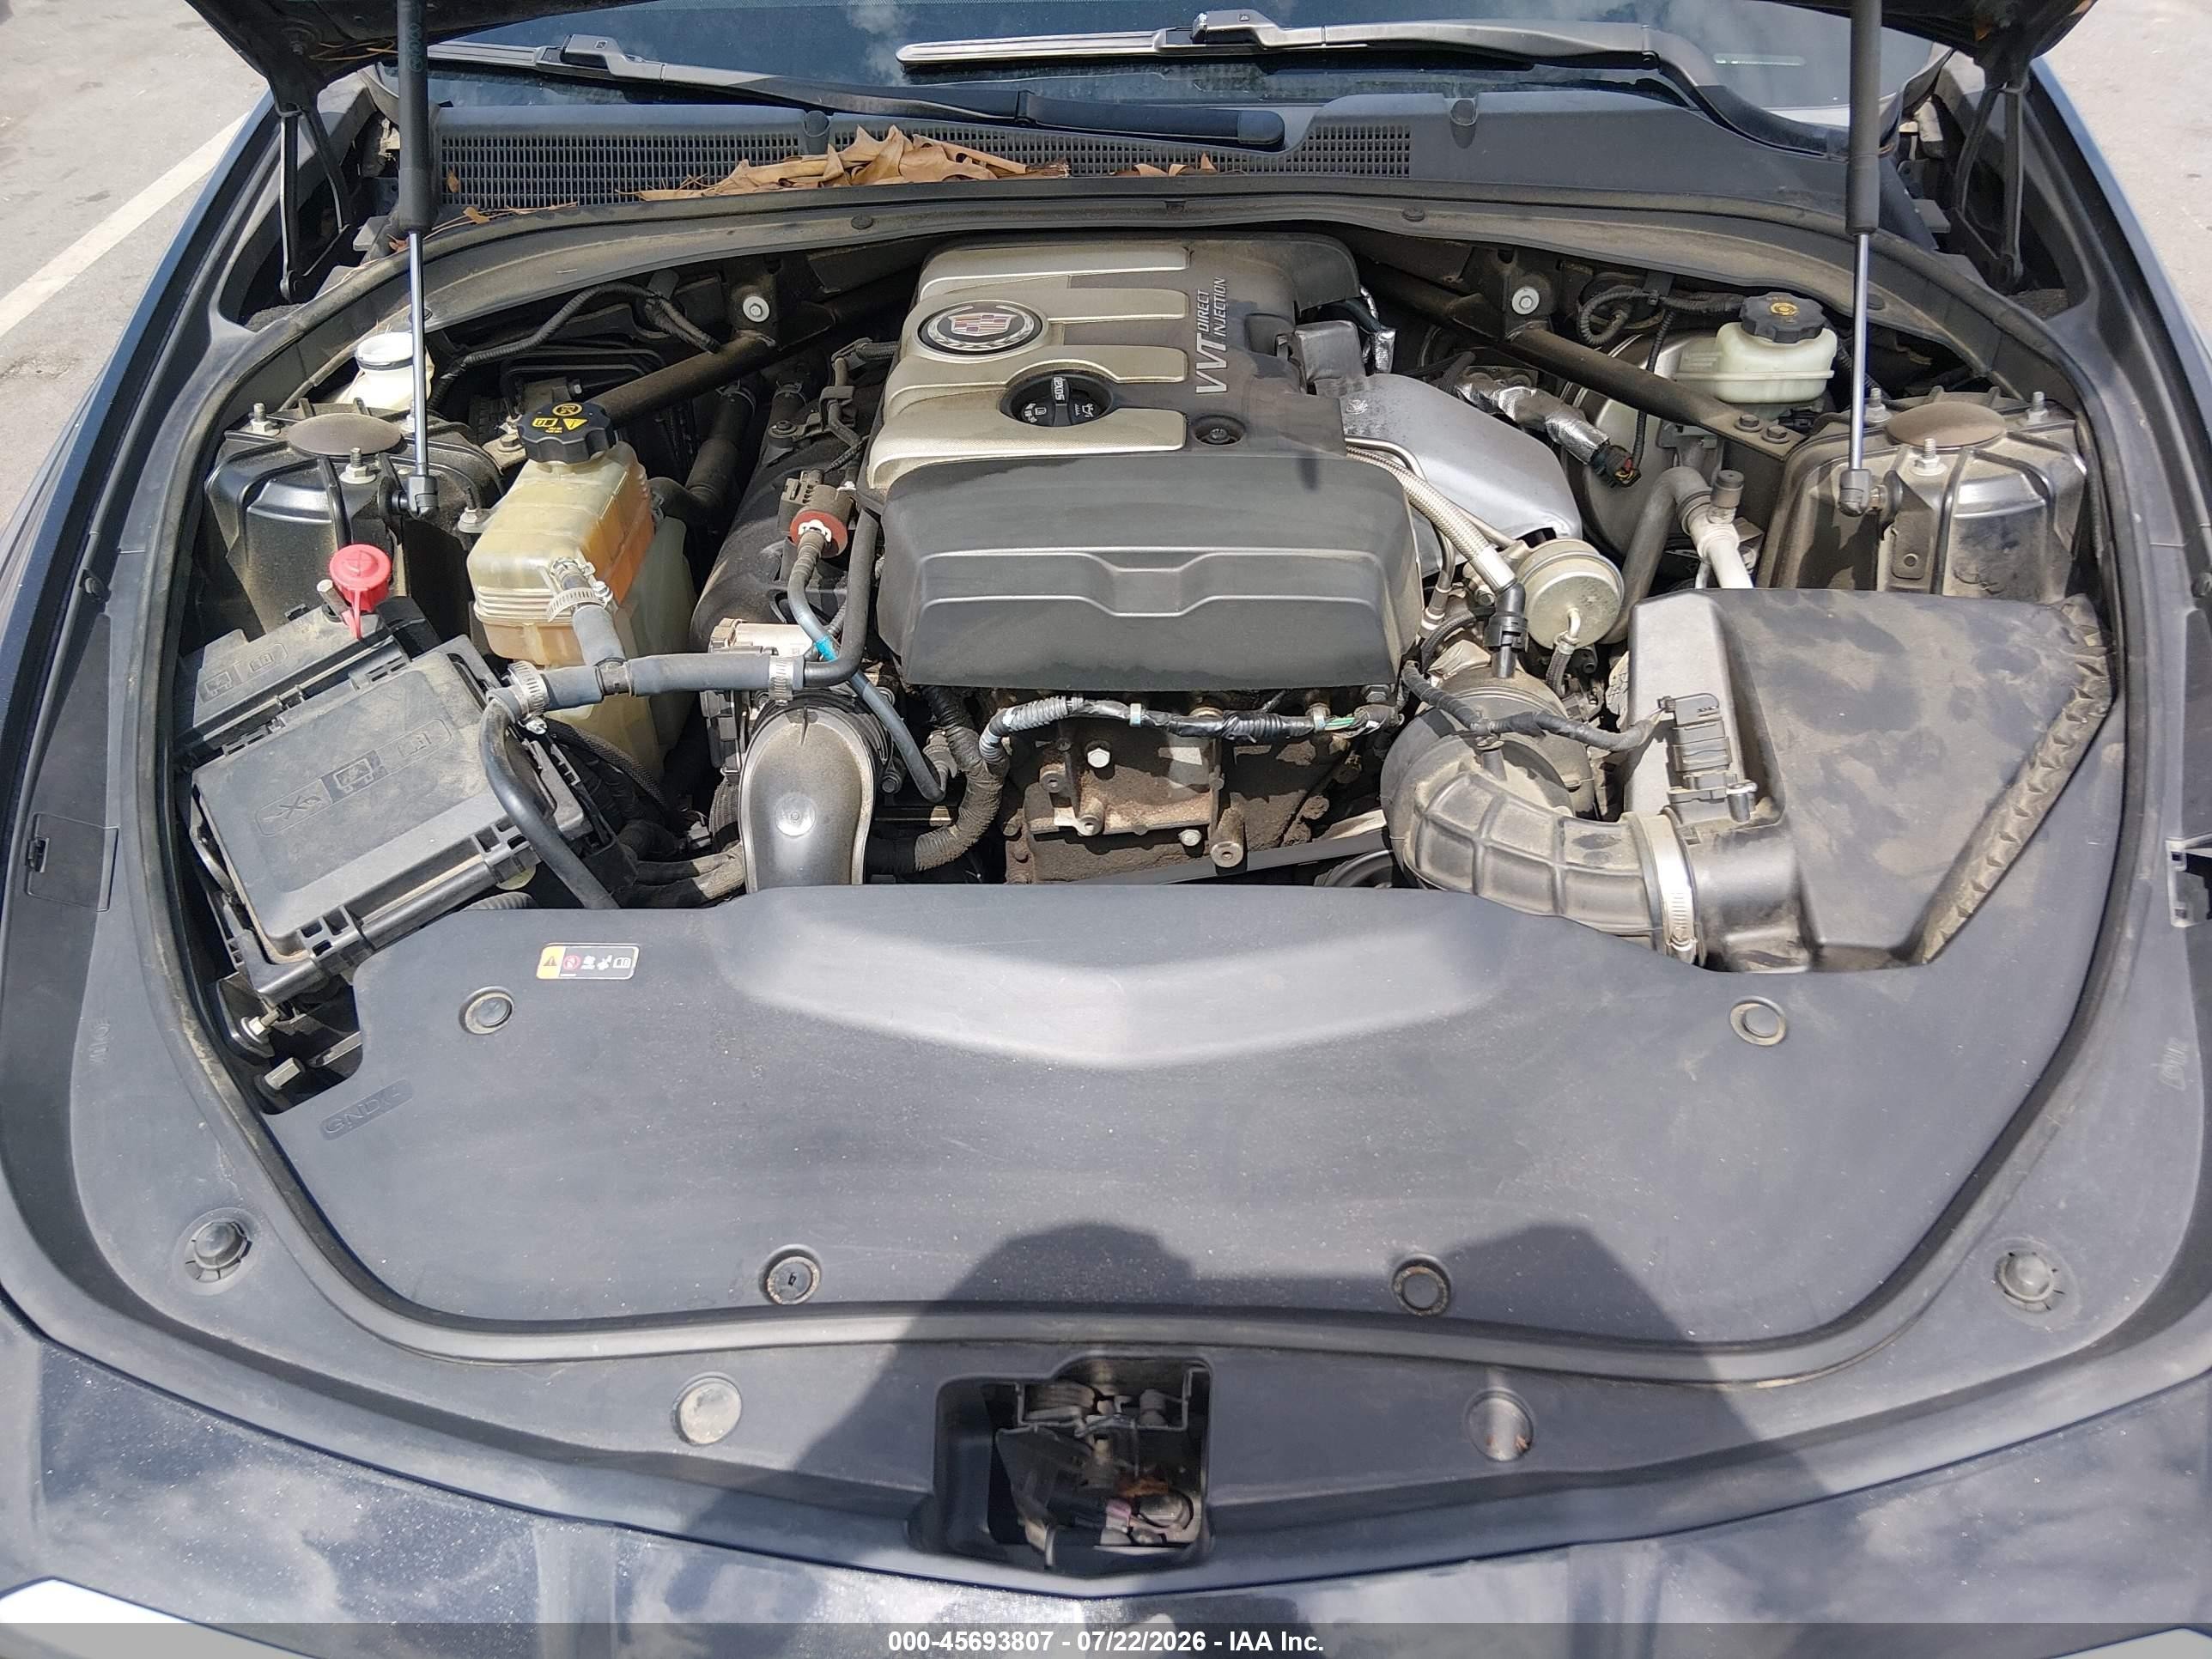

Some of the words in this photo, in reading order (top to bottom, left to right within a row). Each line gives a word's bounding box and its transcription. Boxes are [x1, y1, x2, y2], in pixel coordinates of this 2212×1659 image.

[1197, 289, 1210, 332] DIRECT
[1213, 276, 1227, 337] INJECTION
[1053, 376, 1066, 401] dexos
[1196, 332, 1227, 393] VVT
